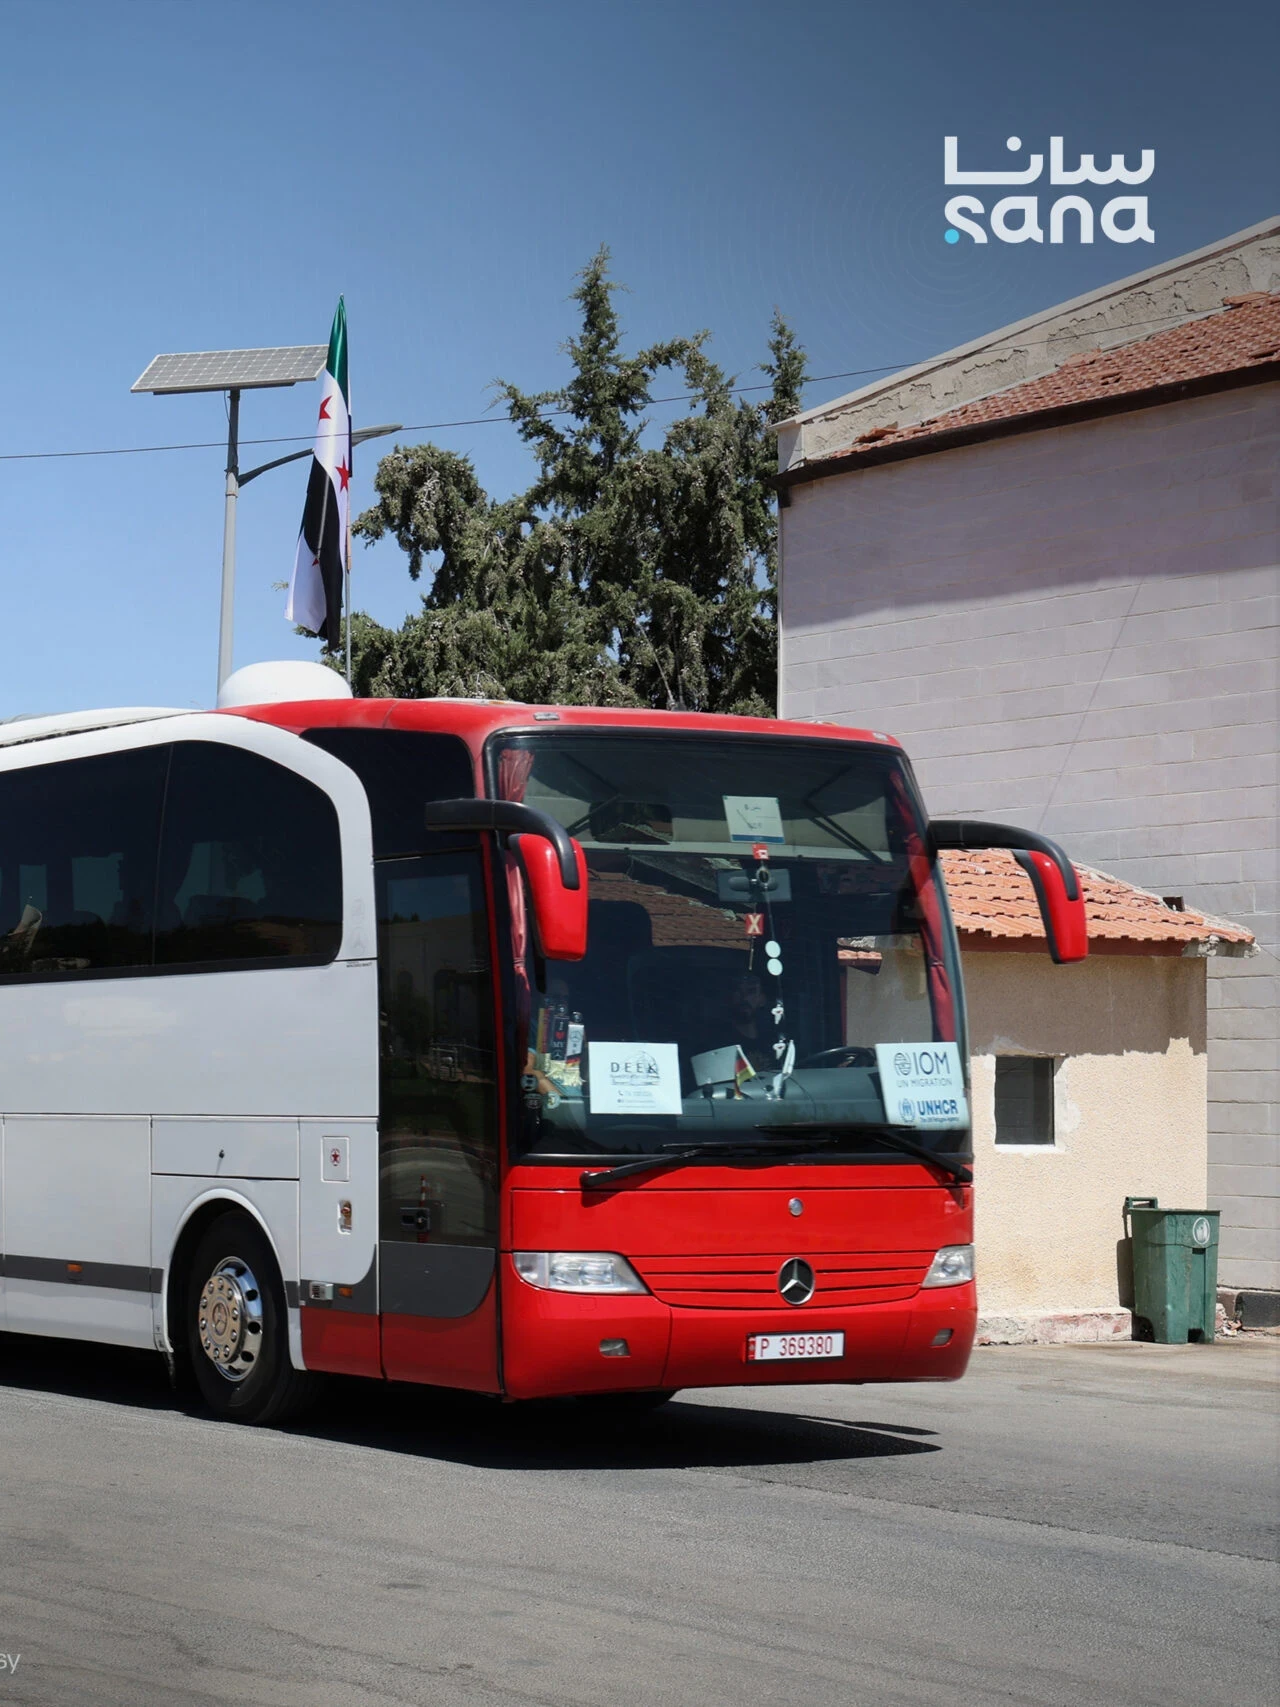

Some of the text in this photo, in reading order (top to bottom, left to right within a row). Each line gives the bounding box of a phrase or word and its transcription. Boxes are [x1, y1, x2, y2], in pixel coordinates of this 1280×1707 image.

[912, 1051, 951, 1075] IOM
[896, 1078, 953, 1088] UN MIGRATION
[917, 1099, 959, 1115] UNHCR
[760, 1336, 833, 1357] P 369380
